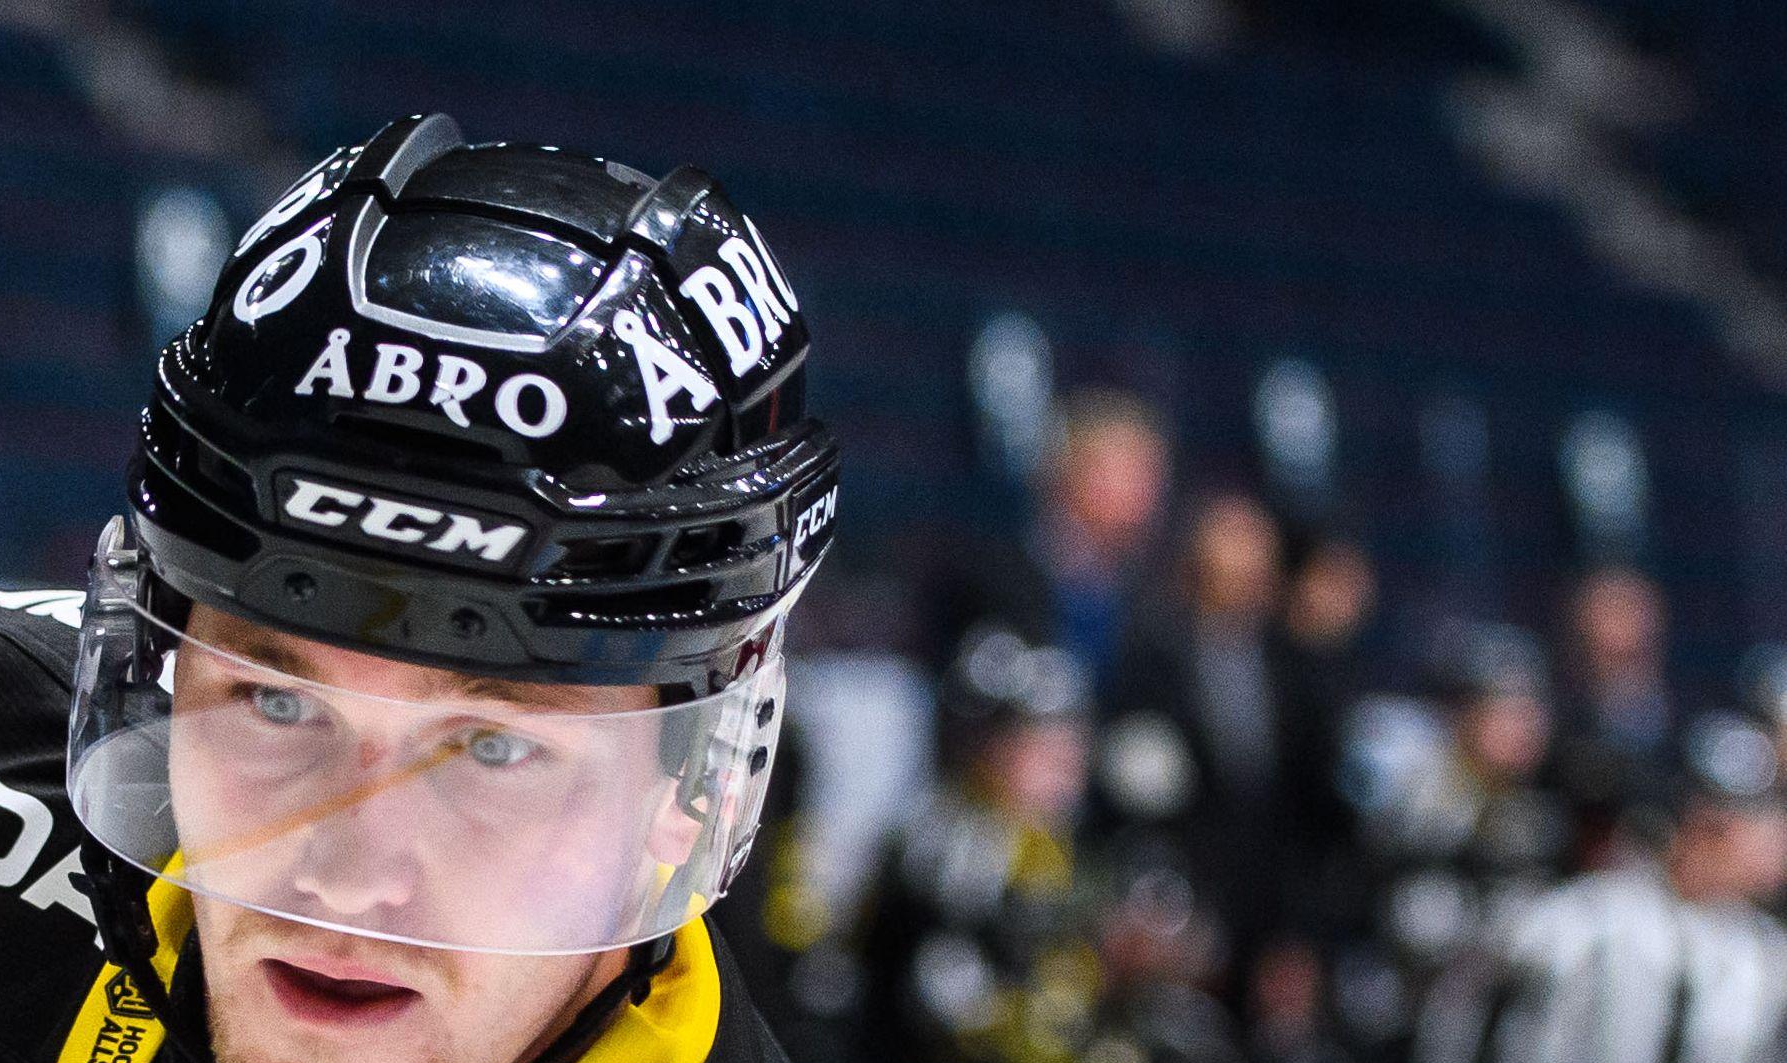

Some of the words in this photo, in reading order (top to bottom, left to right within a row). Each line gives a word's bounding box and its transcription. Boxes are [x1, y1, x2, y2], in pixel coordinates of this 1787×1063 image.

[294, 327, 569, 438] ÅBRO
[282, 477, 530, 563] CCM
[792, 485, 839, 548] CCM
